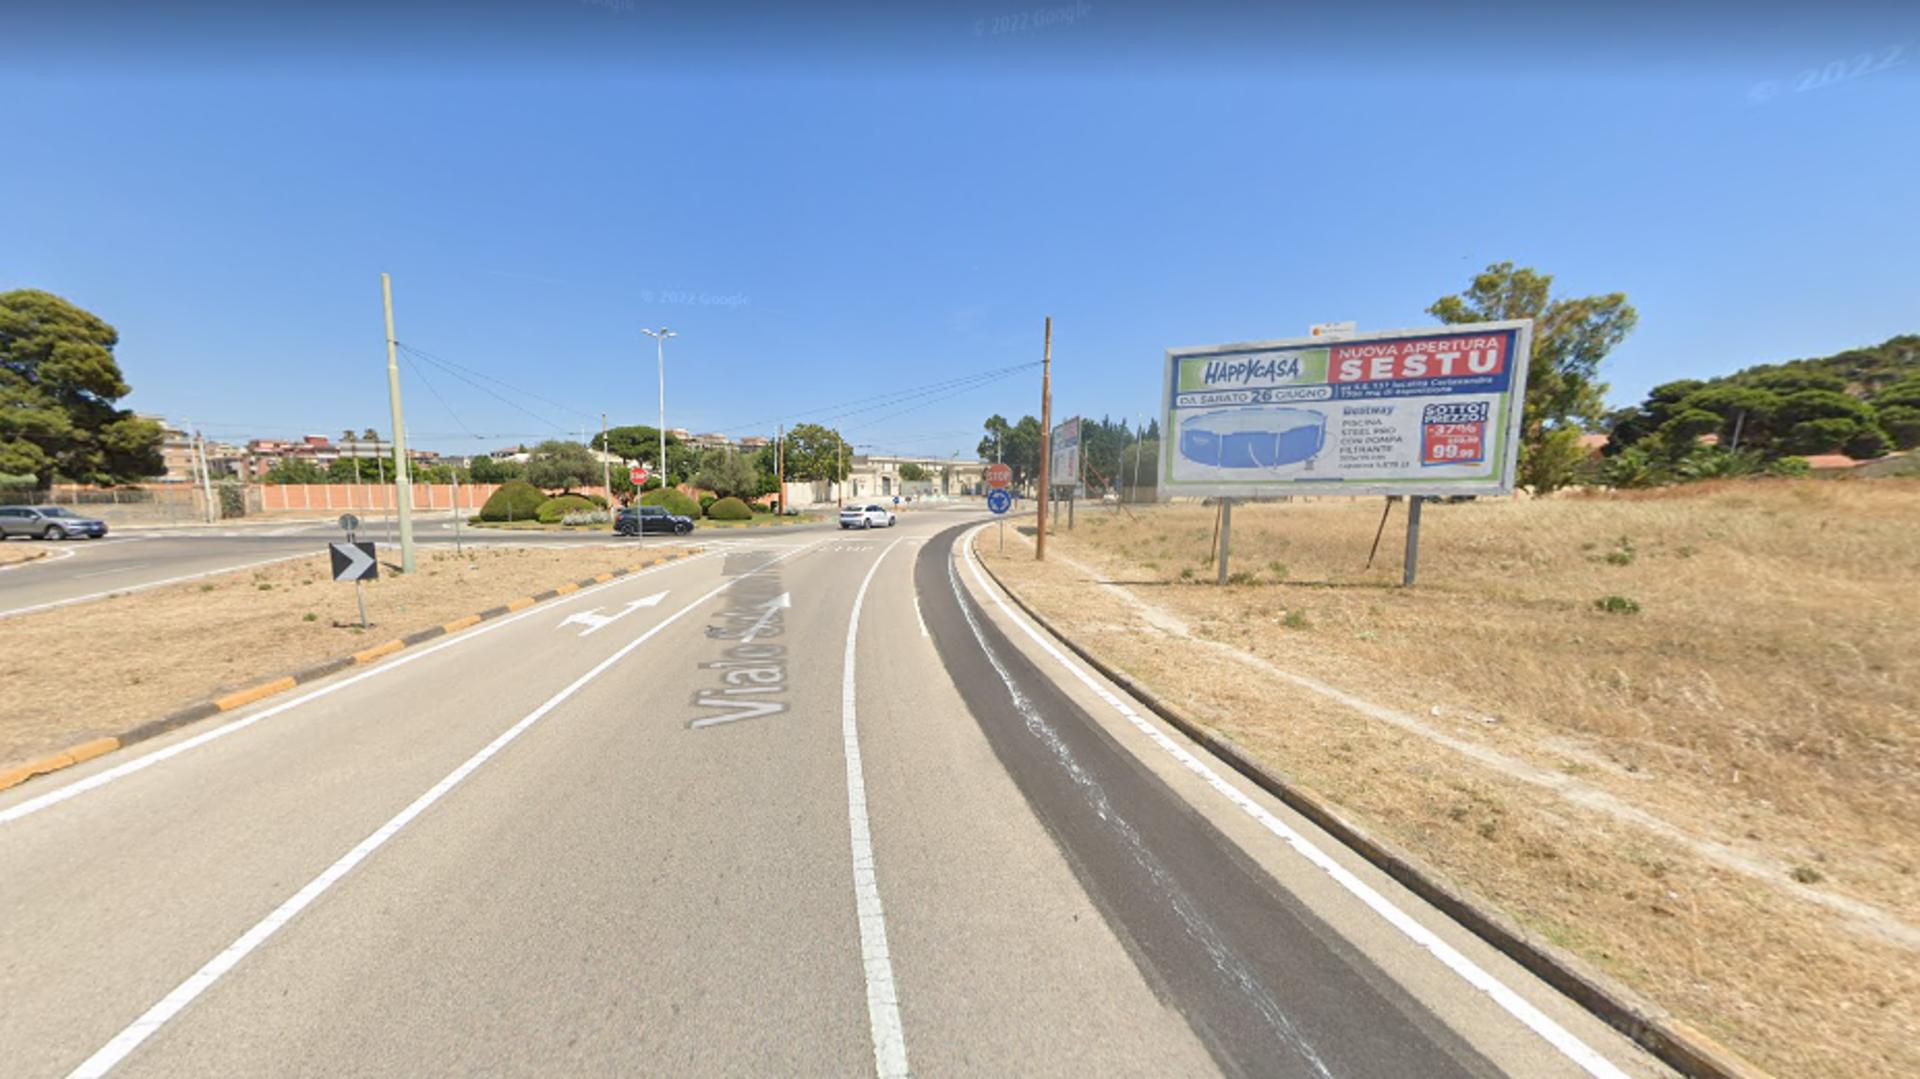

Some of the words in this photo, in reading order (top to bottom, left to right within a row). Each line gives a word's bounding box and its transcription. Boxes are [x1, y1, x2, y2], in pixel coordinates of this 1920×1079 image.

[1339, 344, 1398, 359] NUOVA
[1402, 337, 1499, 353] APERTURA
[1338, 349, 1497, 381] SESTU
[1179, 396, 1197, 405] DA
[1200, 393, 1249, 405] SABATO
[1250, 389, 1272, 402] 26
[1275, 387, 1329, 400] GIUGNO
